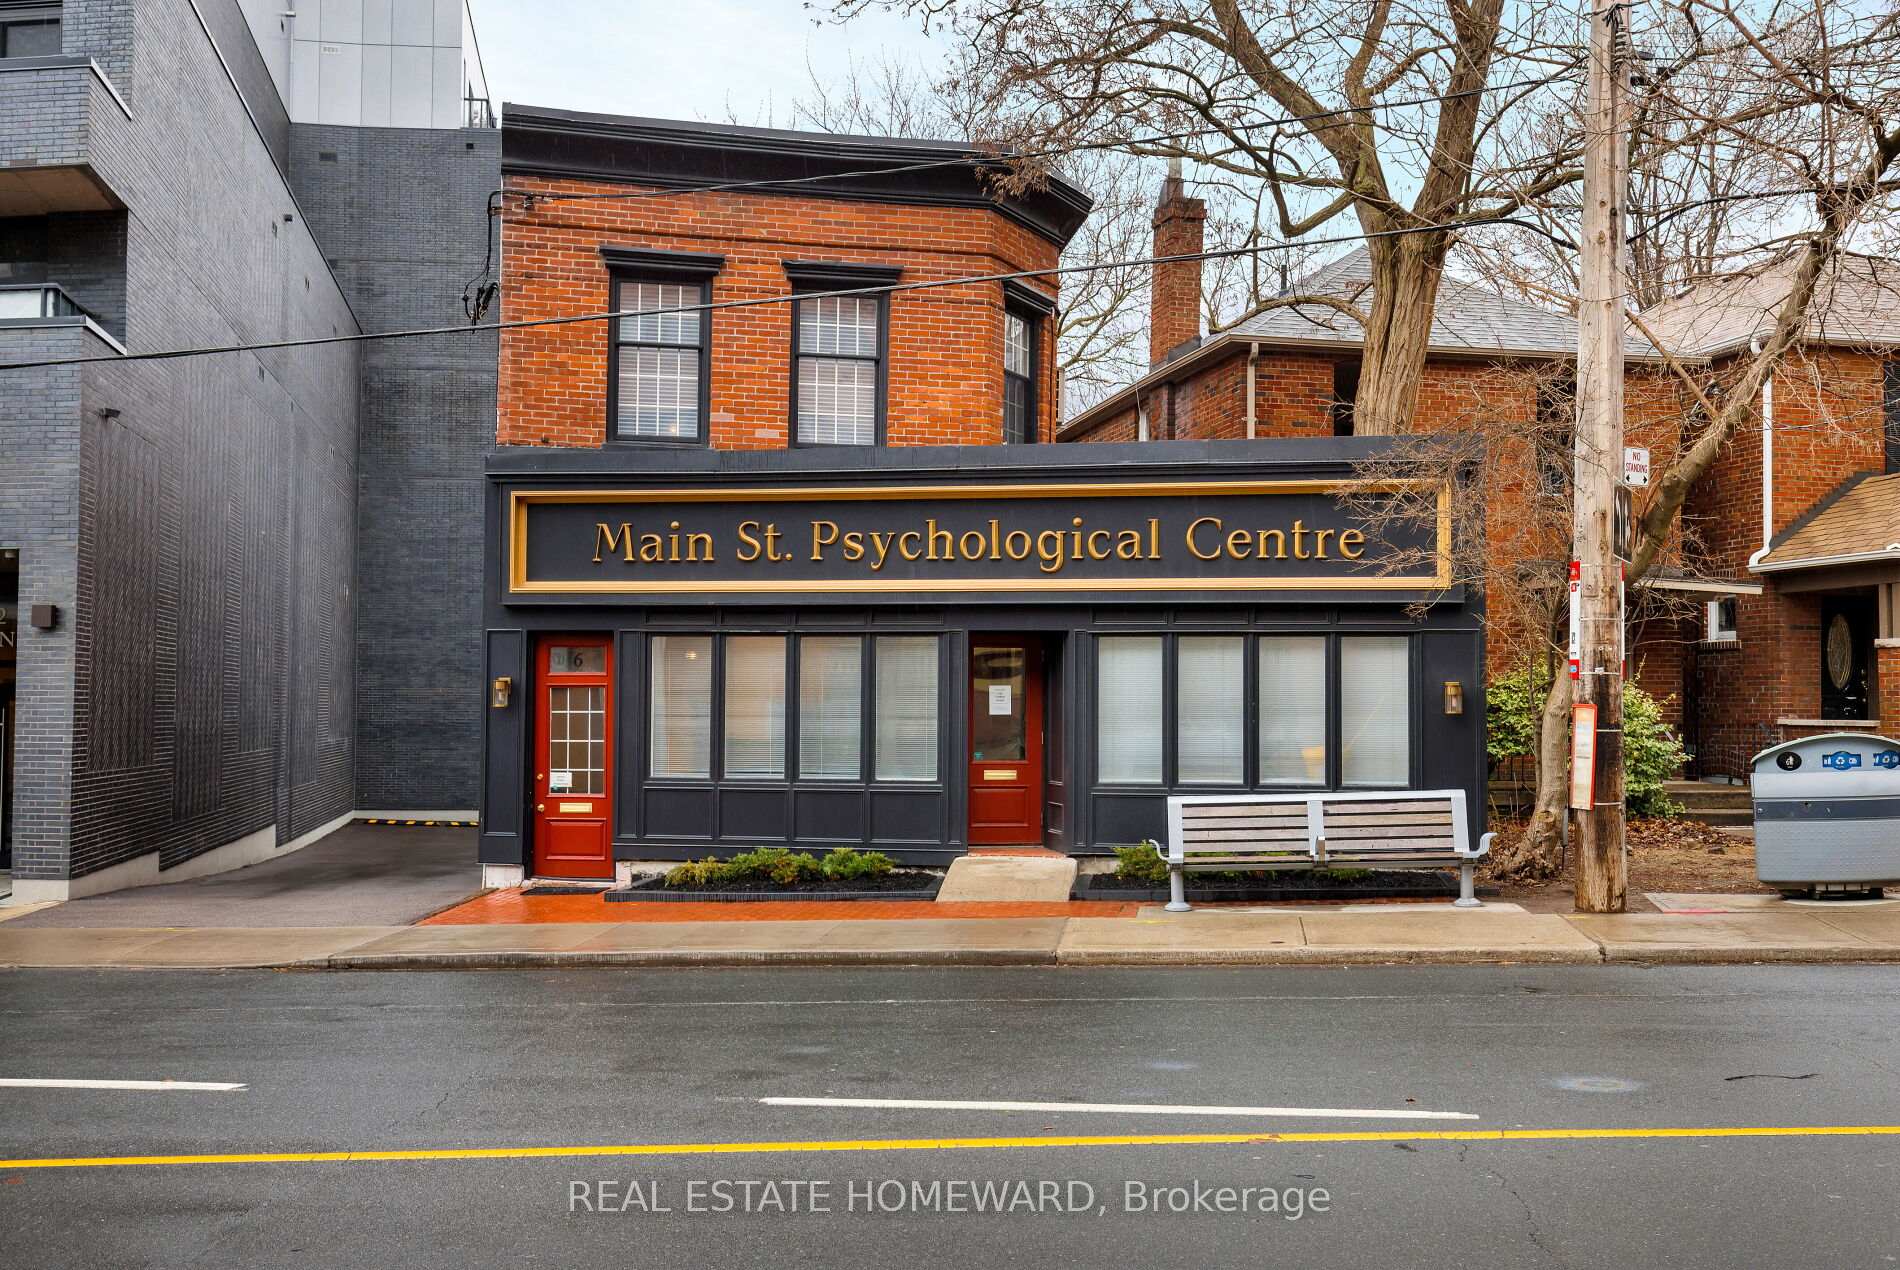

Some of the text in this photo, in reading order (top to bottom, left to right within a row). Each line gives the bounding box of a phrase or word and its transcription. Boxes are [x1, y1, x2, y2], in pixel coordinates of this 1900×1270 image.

[1633, 452, 1641, 461] NO
[1625, 462, 1648, 474] STANDING
[592, 518, 1367, 573] Main St. Psychological Centre
[574, 652, 583, 668] 6
